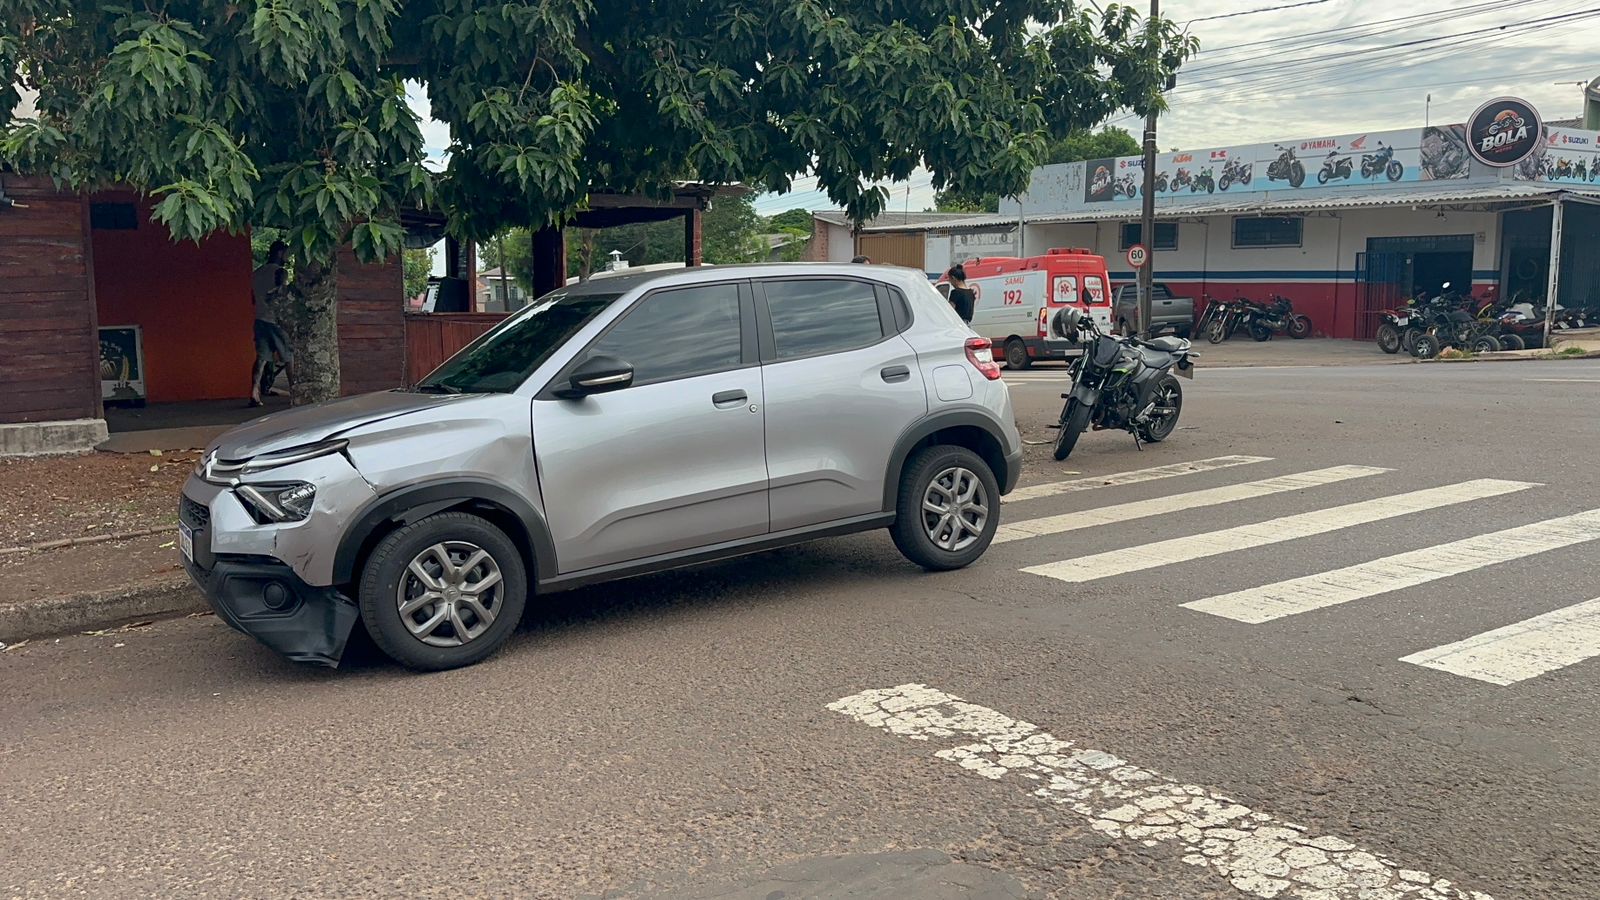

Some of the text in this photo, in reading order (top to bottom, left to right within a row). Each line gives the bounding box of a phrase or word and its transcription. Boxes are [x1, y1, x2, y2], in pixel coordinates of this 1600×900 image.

[1481, 126, 1528, 152] BOLA
[1568, 136, 1589, 145] SUZUKI
[1308, 139, 1336, 150] YAMAHA
[1172, 154, 1192, 163] KTM
[1127, 160, 1145, 168] SUZ
[1131, 250, 1143, 259] 60
[1004, 276, 1025, 286] SAMU
[1003, 289, 1022, 305] 192
[1090, 289, 1101, 299] 92
